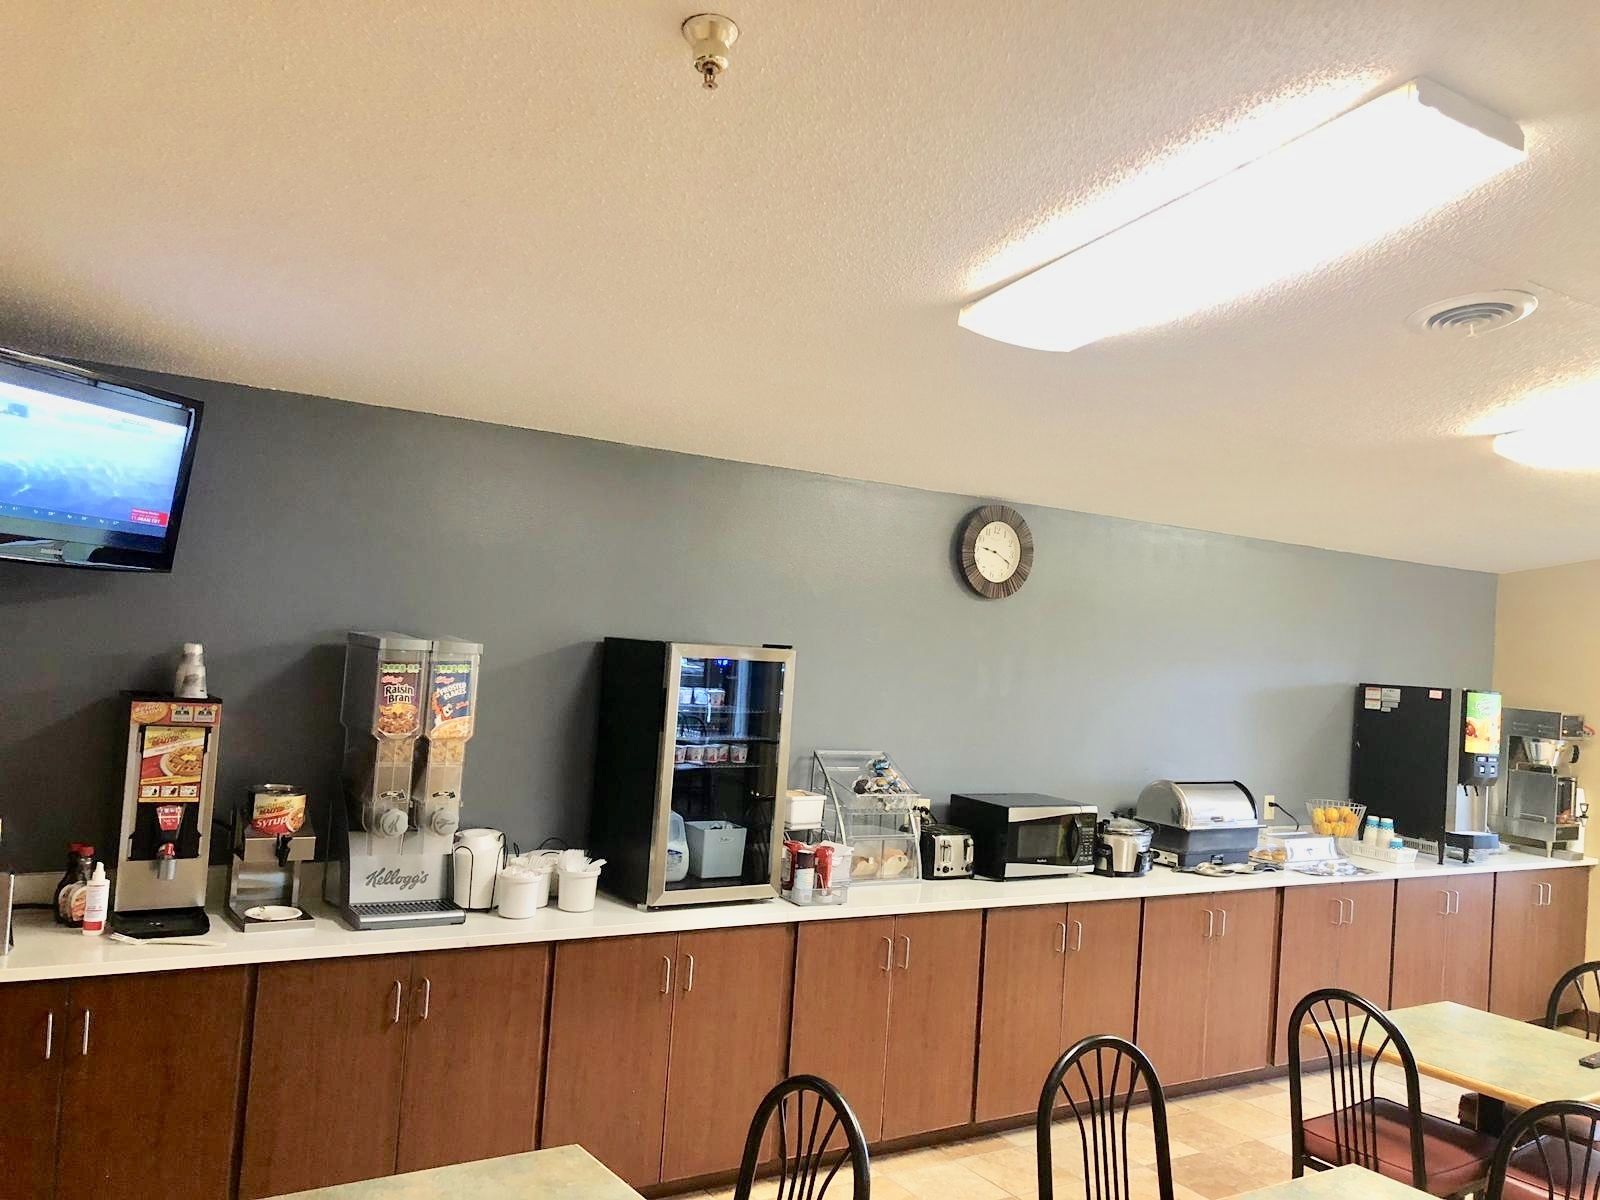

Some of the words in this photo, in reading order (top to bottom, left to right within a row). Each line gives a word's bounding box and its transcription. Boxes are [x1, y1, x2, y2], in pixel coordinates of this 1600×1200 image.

[385, 685, 414, 696] Raisin
[388, 695, 411, 703] Bran
[365, 867, 429, 890] Kellogg's
